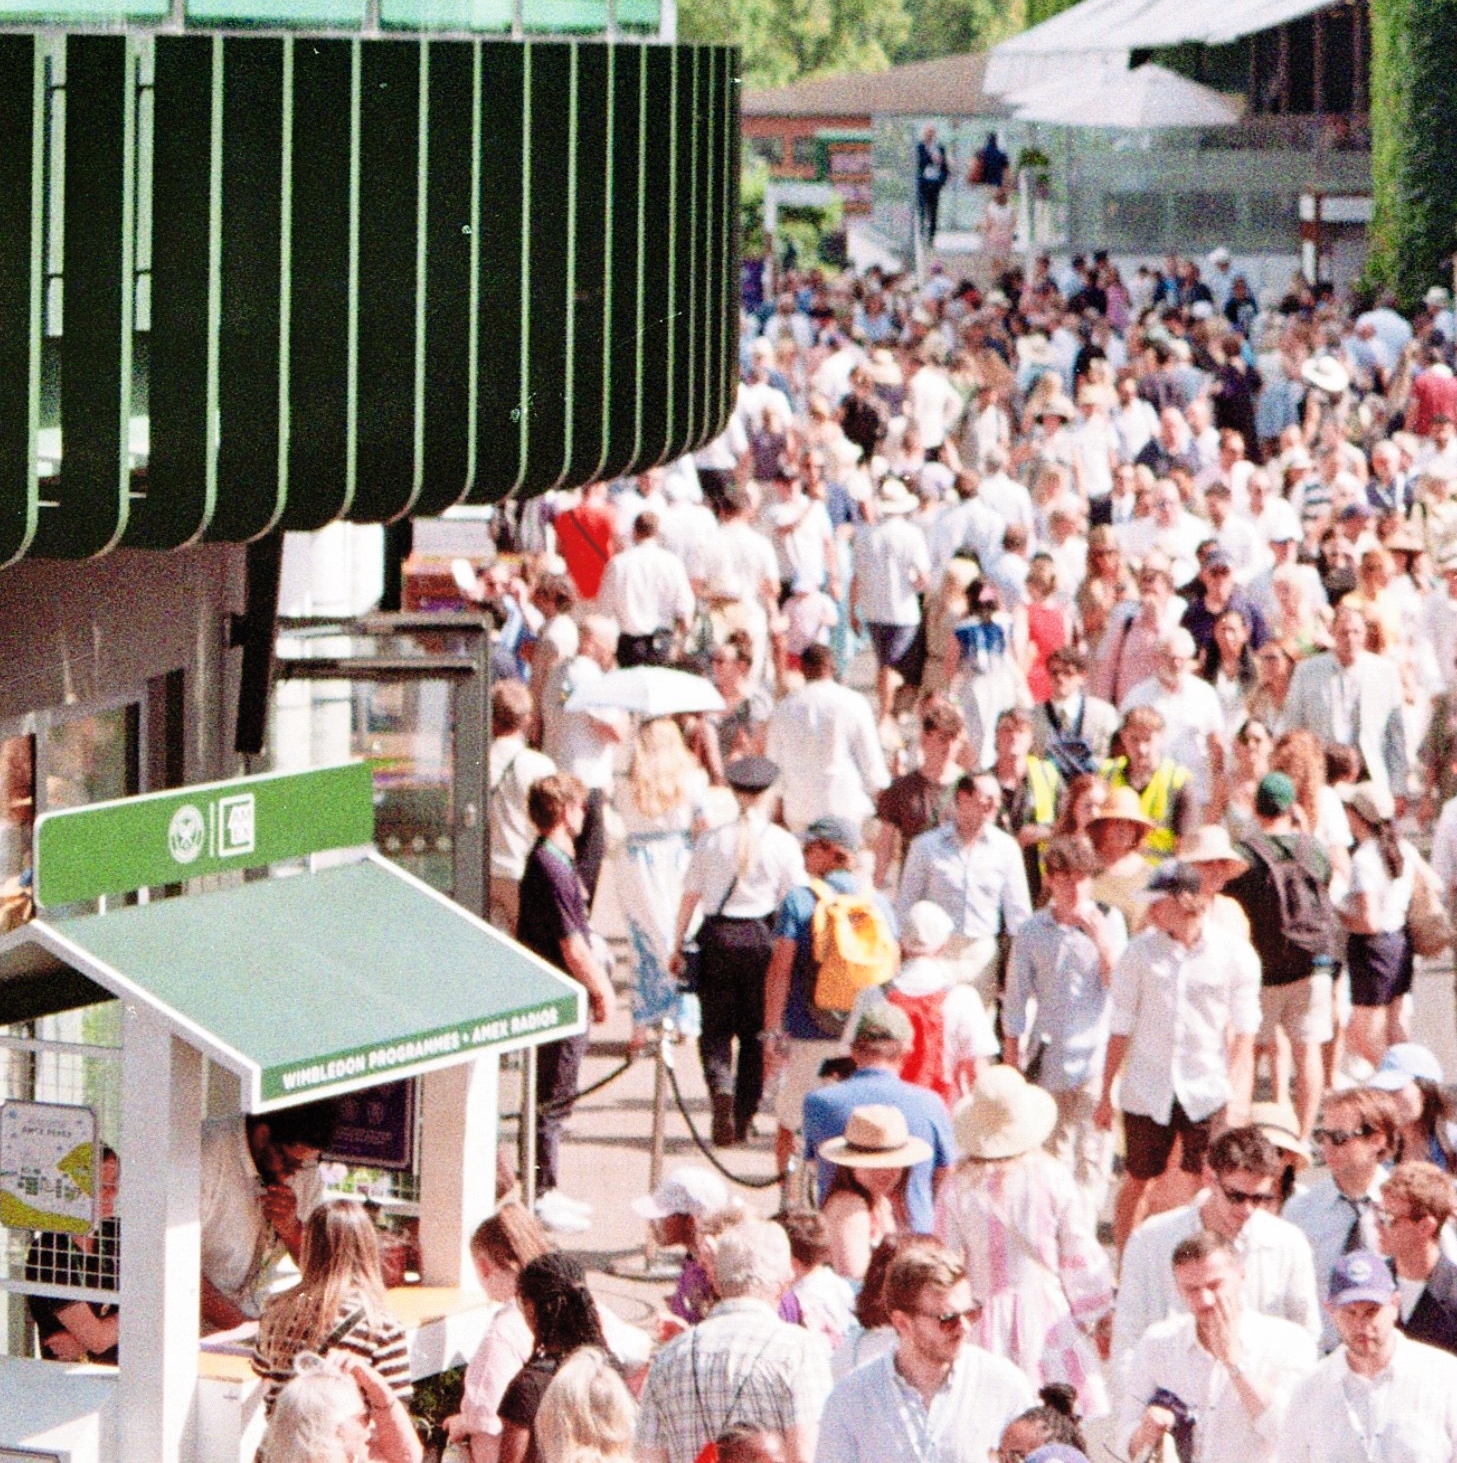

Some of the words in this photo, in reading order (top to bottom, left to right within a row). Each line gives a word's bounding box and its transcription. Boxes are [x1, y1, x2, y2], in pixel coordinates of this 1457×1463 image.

[282, 1055, 367, 1090] WIMBLEDON
[369, 1032, 461, 1068] PROGRAMMES
[472, 1019, 510, 1042] AMEX
[512, 1007, 560, 1038] RADIOS
